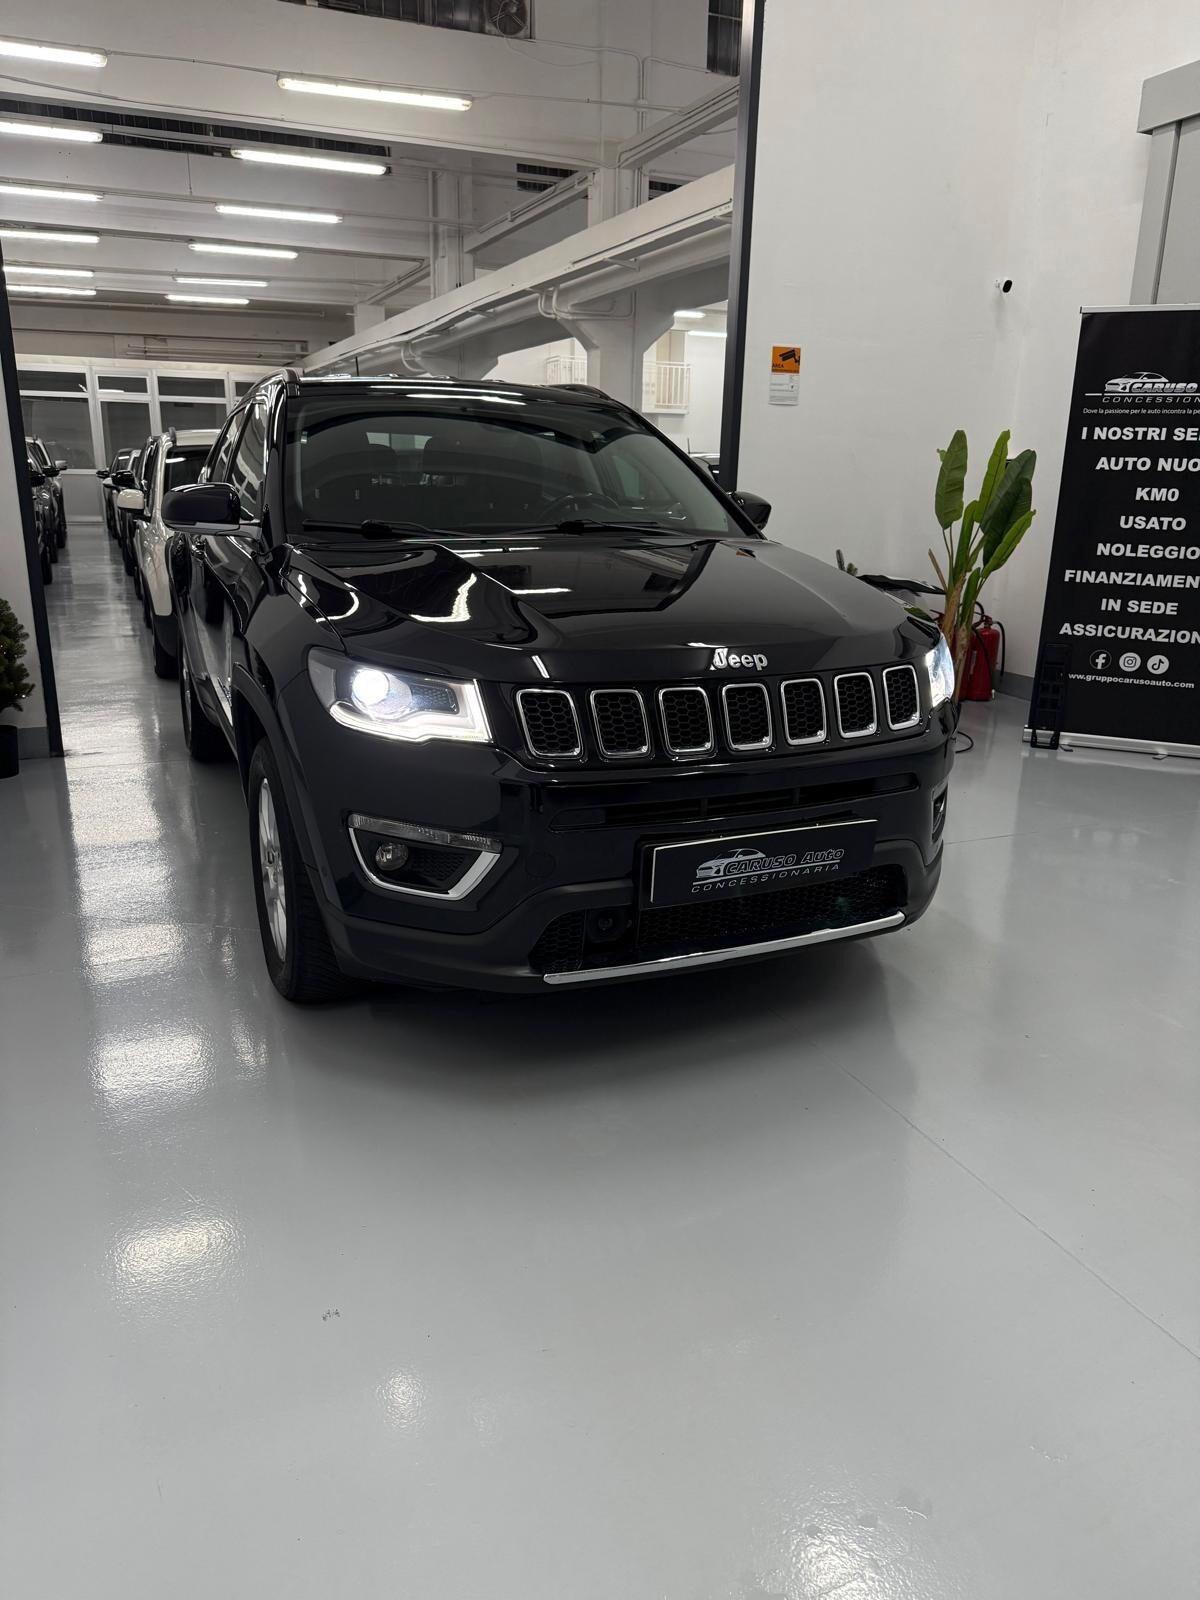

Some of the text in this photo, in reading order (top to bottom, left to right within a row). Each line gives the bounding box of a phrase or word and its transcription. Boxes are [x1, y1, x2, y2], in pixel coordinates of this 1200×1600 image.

[1131, 383, 1198, 392] CARUSO
[1104, 408, 1129, 416] passione
[1081, 427, 1200, 441] I NOSTRI SE
[1095, 457, 1200, 472] AUTO NUO
[1119, 516, 1187, 531] USATO
[1096, 543, 1200, 560] NOLEGGIO
[1064, 569, 1200, 589] FINANZIAMEN
[1100, 598, 1179, 615] IN SEDE
[1059, 623, 1200, 644] ASSICURAZION
[713, 648, 768, 671] Jeep
[726, 854, 797, 875] CARUSO
[691, 863, 840, 893] CONCESSIONARIA
